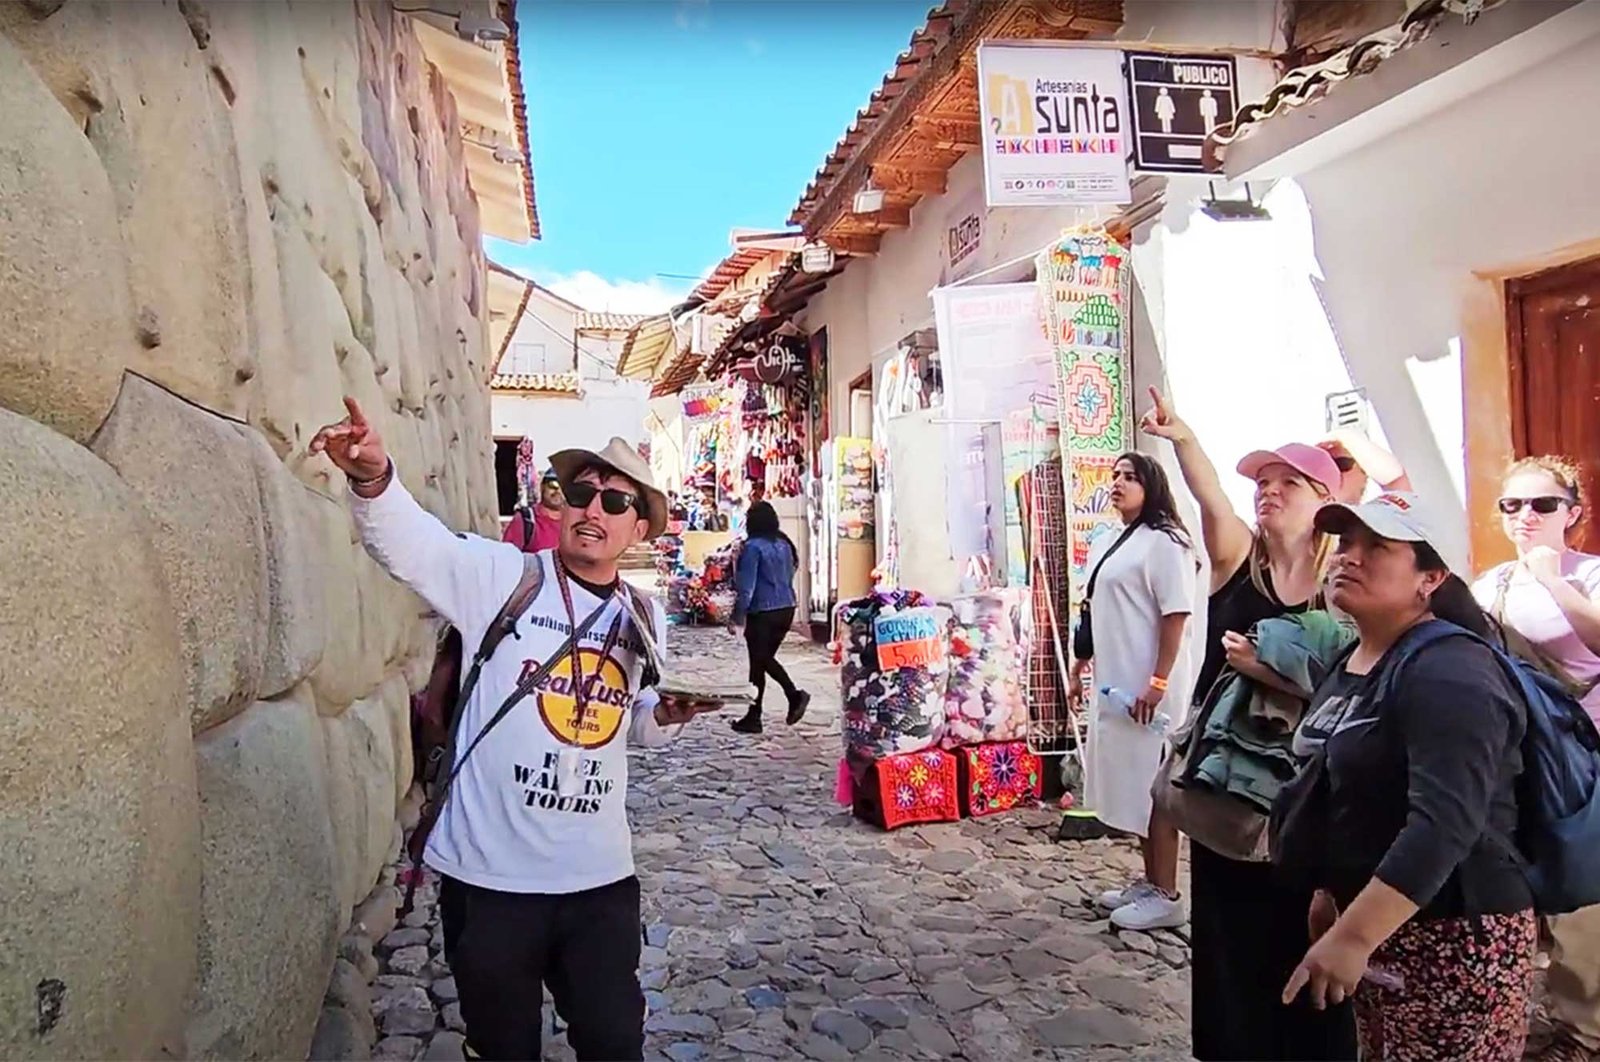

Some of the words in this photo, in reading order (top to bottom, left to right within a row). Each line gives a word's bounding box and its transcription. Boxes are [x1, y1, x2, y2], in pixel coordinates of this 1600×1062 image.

[1173, 64, 1228, 85] PUBLICO
[516, 658, 577, 697] Rea
[572, 705, 599, 719] FEE
[566, 718, 600, 733] TOURS
[543, 752, 602, 777] FE
[514, 763, 613, 795] WALING
[525, 789, 601, 814] TOURS
